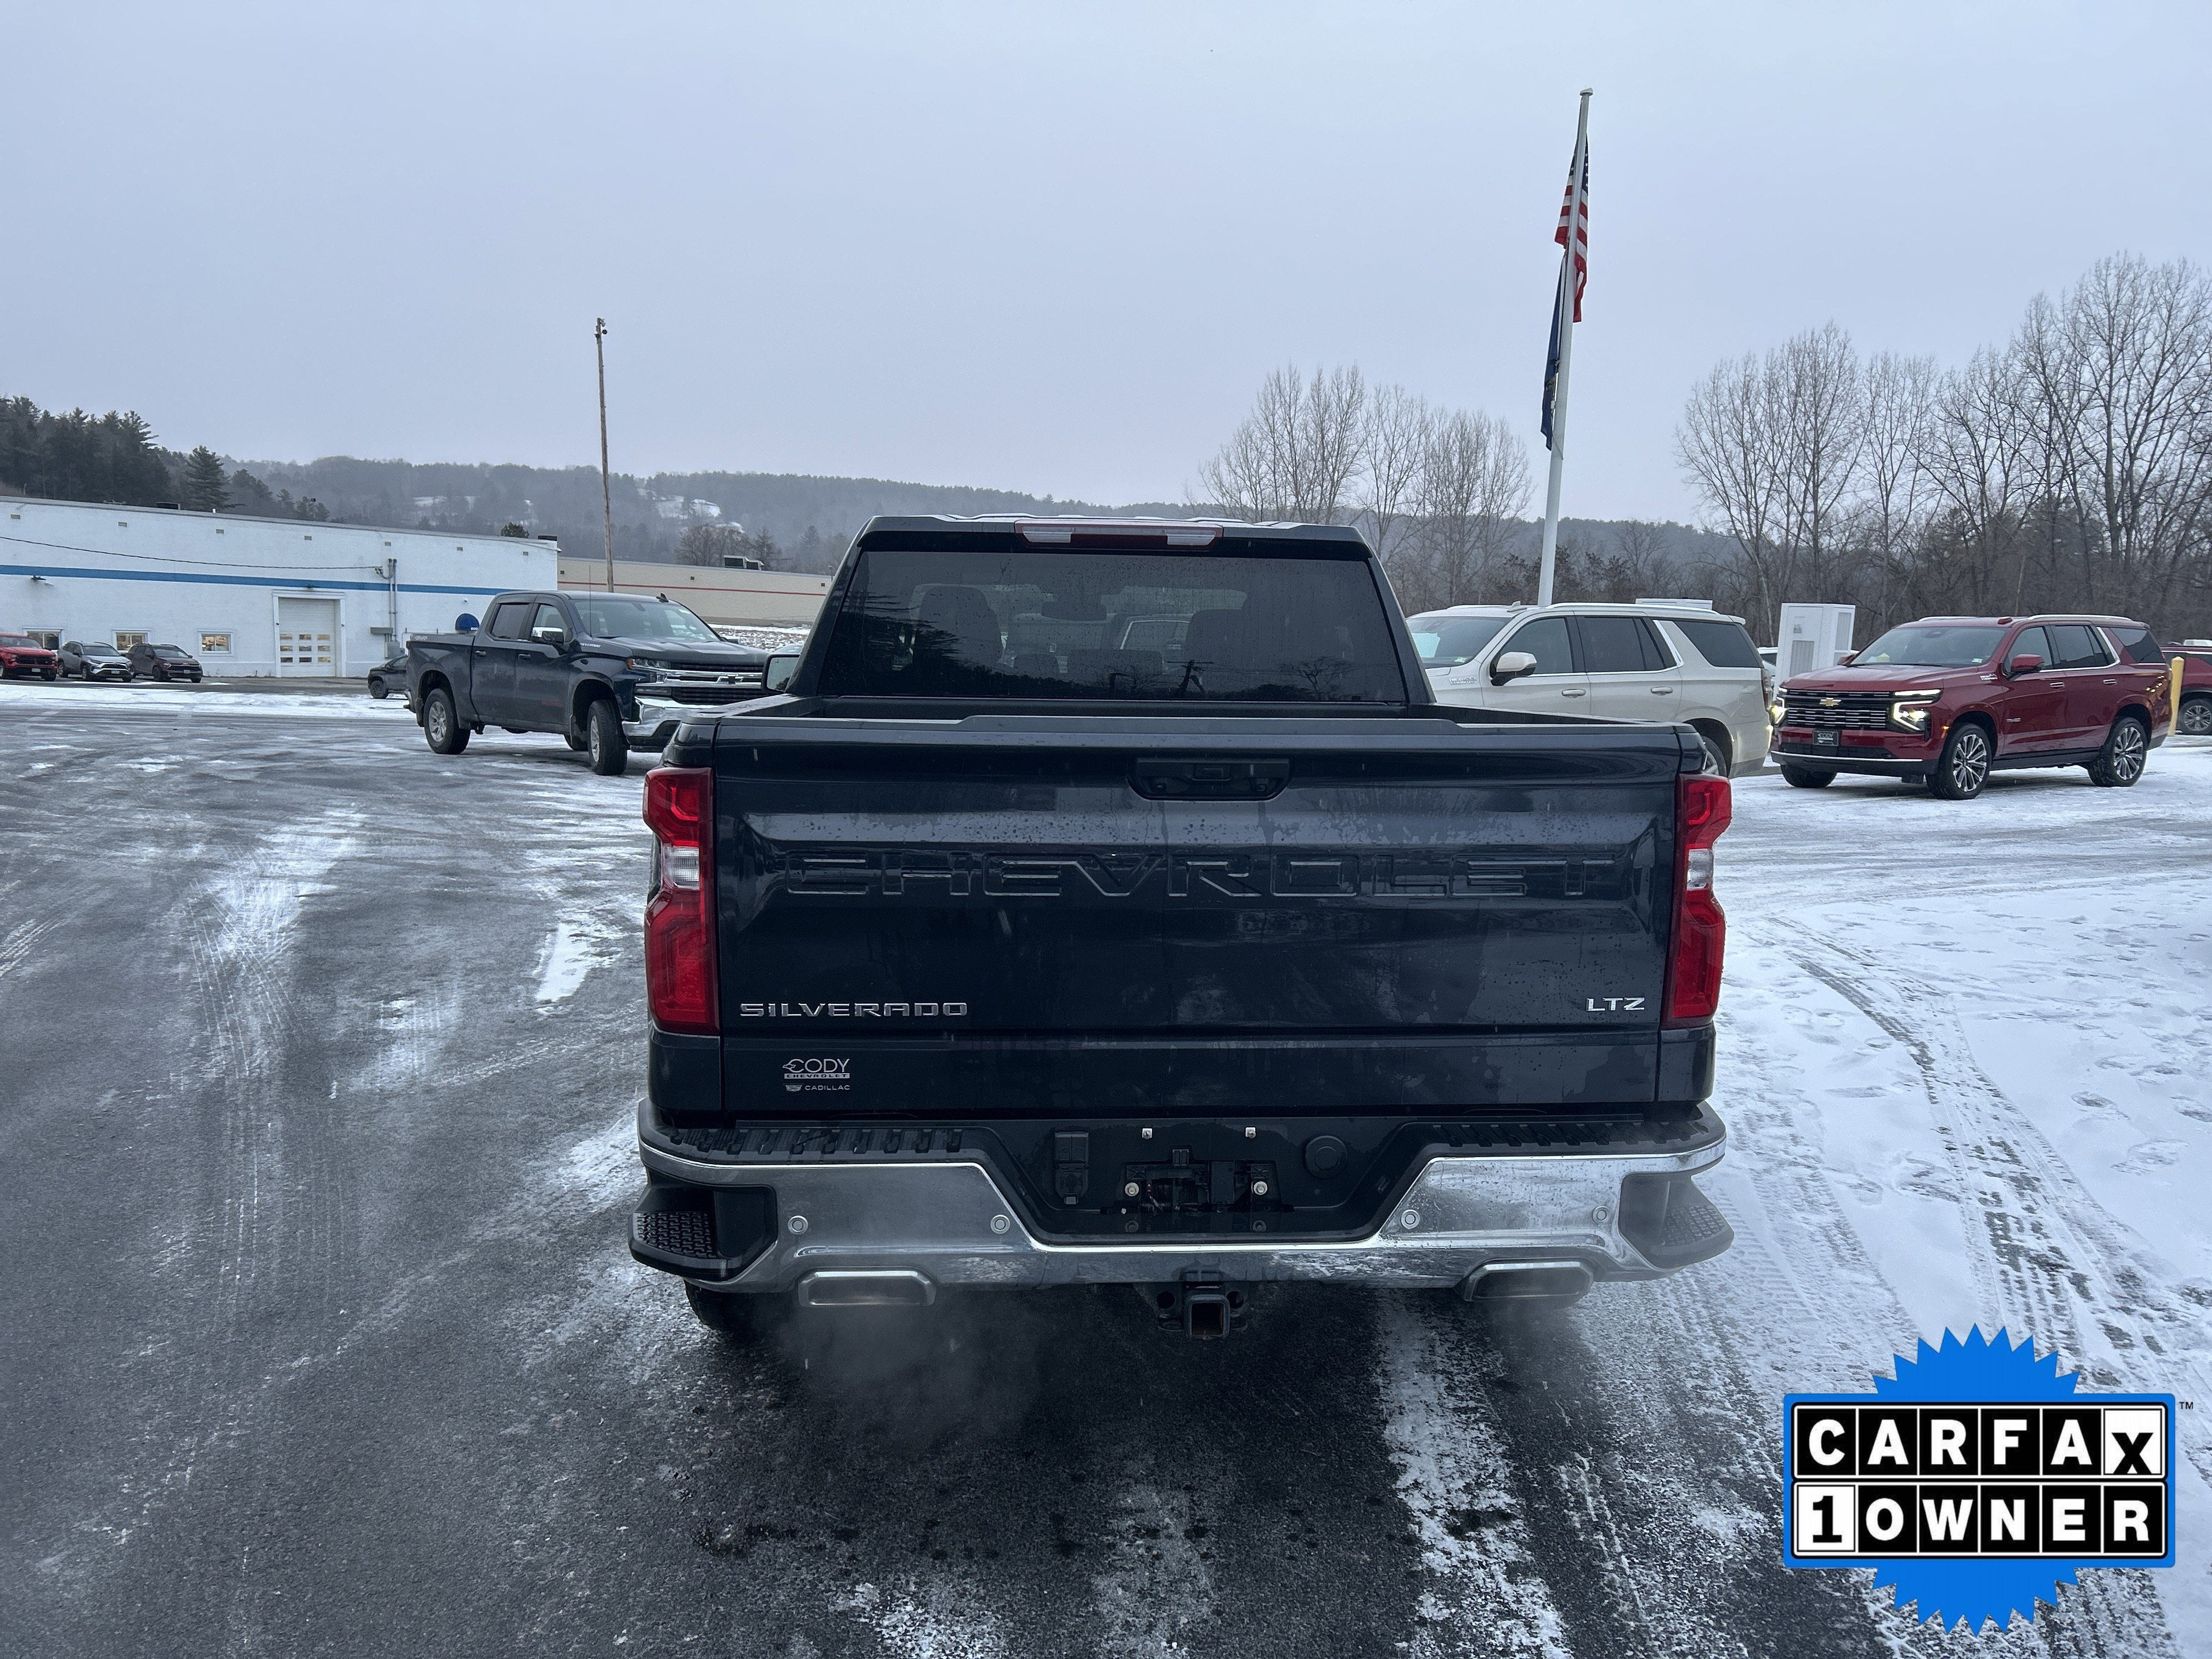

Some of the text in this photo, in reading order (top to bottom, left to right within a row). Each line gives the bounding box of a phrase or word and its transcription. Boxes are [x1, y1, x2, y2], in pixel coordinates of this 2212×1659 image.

[786, 850, 1615, 898] CHEVROLET
[740, 1002, 968, 1017] SILVERADO
[1585, 997, 1645, 1012] LTZ
[782, 1058, 850, 1073] CODY
